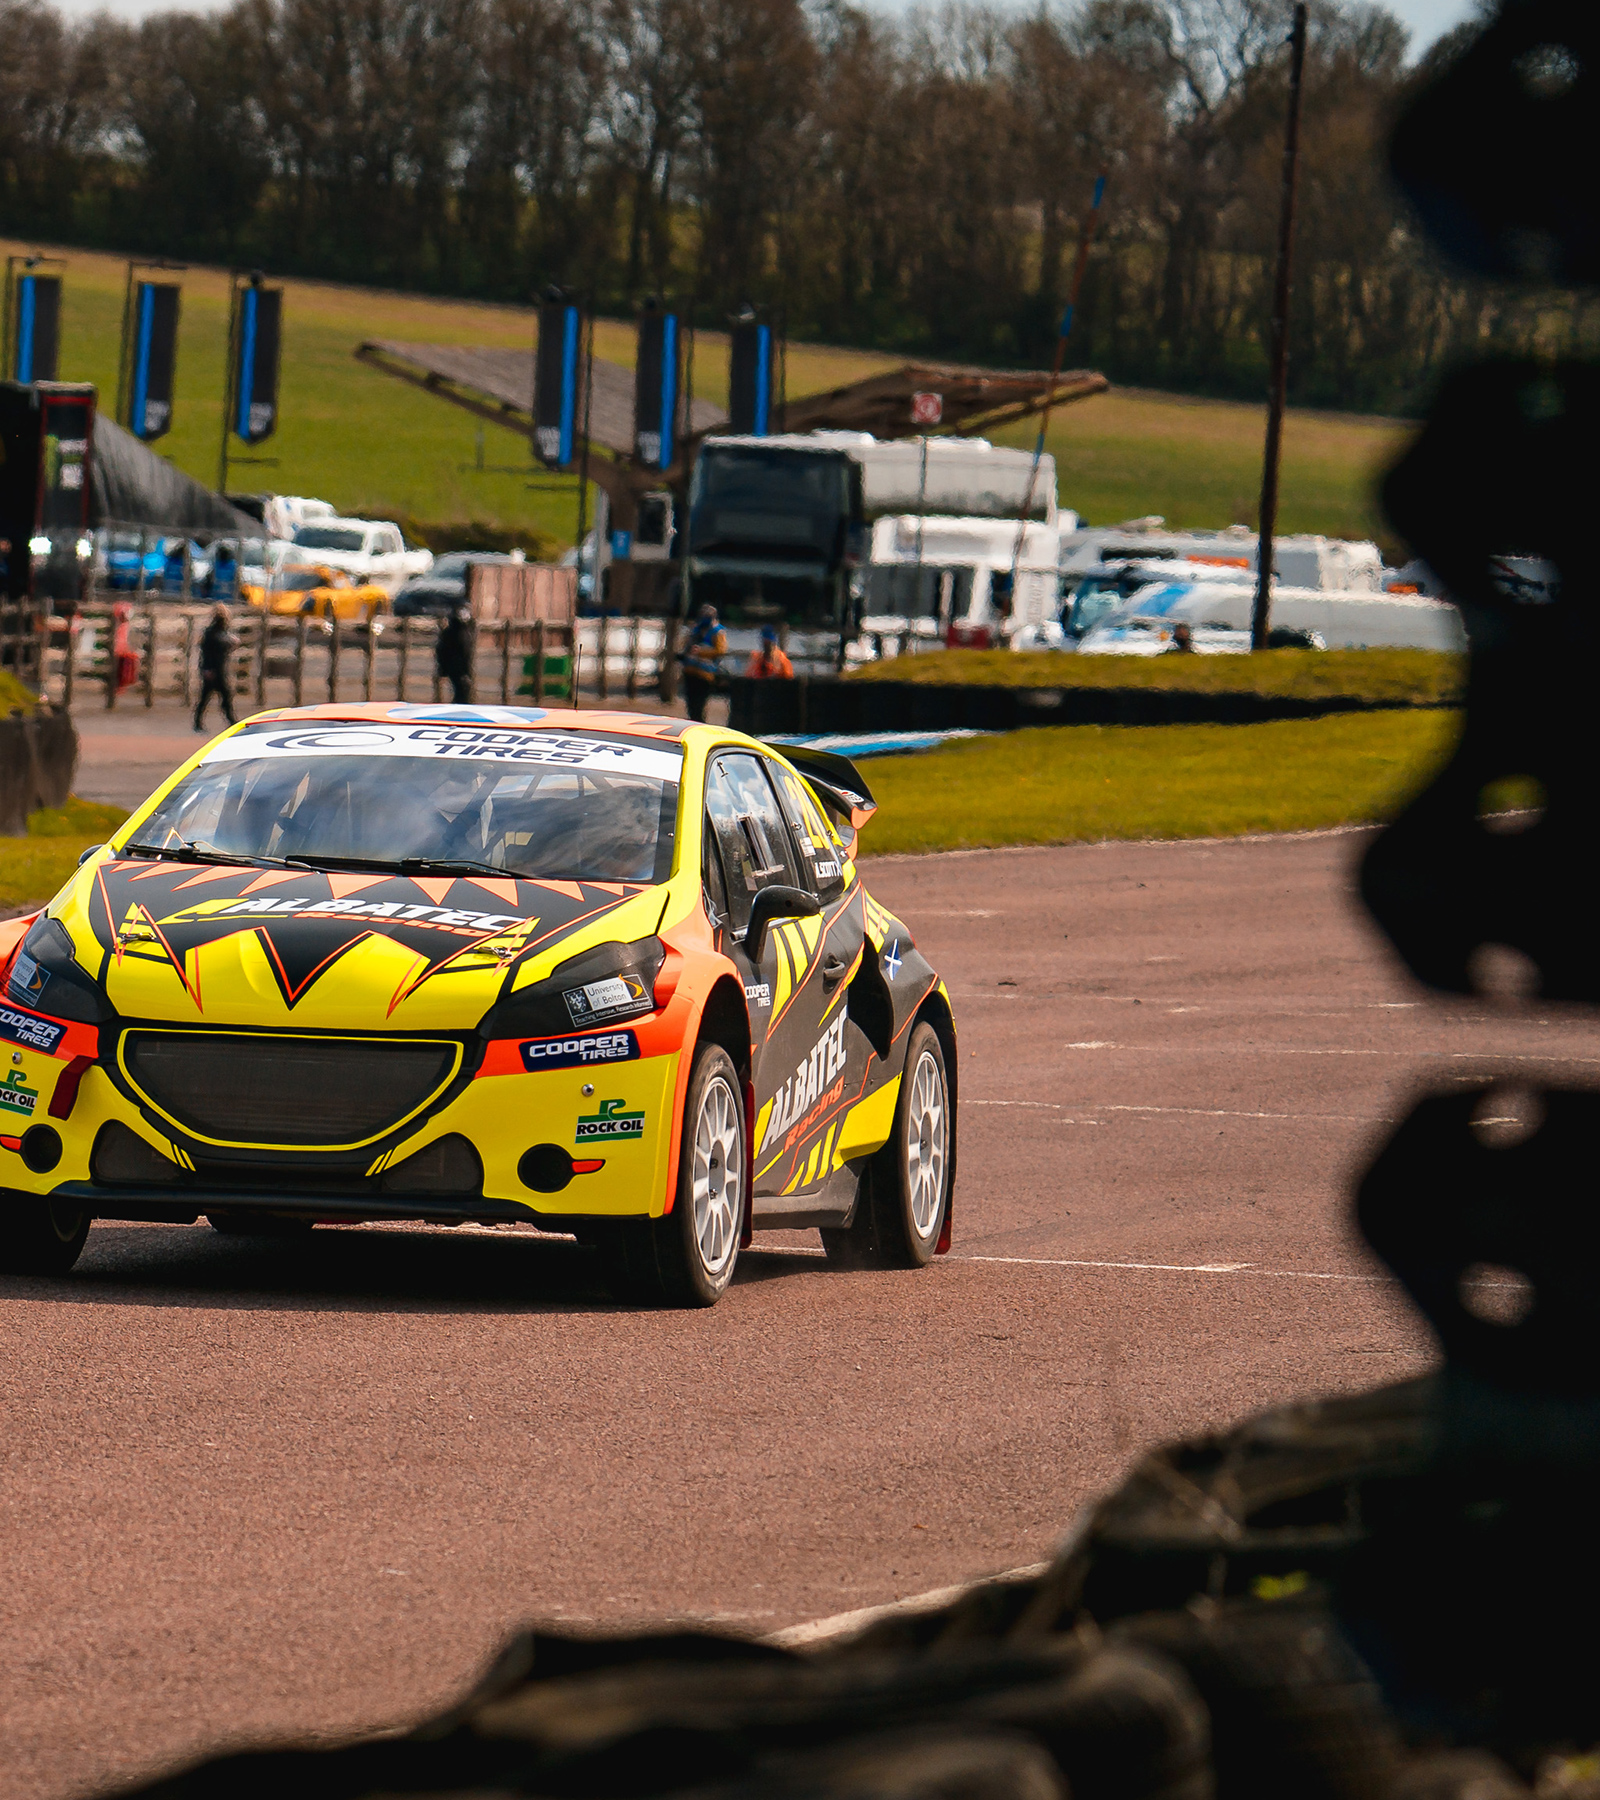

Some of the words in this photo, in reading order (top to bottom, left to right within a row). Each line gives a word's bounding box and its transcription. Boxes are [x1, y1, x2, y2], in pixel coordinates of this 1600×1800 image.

[408, 729, 633, 757] COOPER
[434, 743, 594, 764] TIRES
[220, 897, 527, 931] ALBATEC
[587, 983, 624, 998] University
[745, 984, 771, 998] COOPER
[593, 999, 602, 1007] of
[602, 993, 627, 1005] Bolton
[16, 1028, 53, 1048] TIRES
[529, 1033, 629, 1058] COOPER
[579, 1046, 629, 1061] TIRES
[760, 1005, 847, 1154] ALBATEC
[18, 1094, 36, 1109] OIL
[576, 1121, 618, 1135] ROCK
[620, 1119, 643, 1131] OIL
